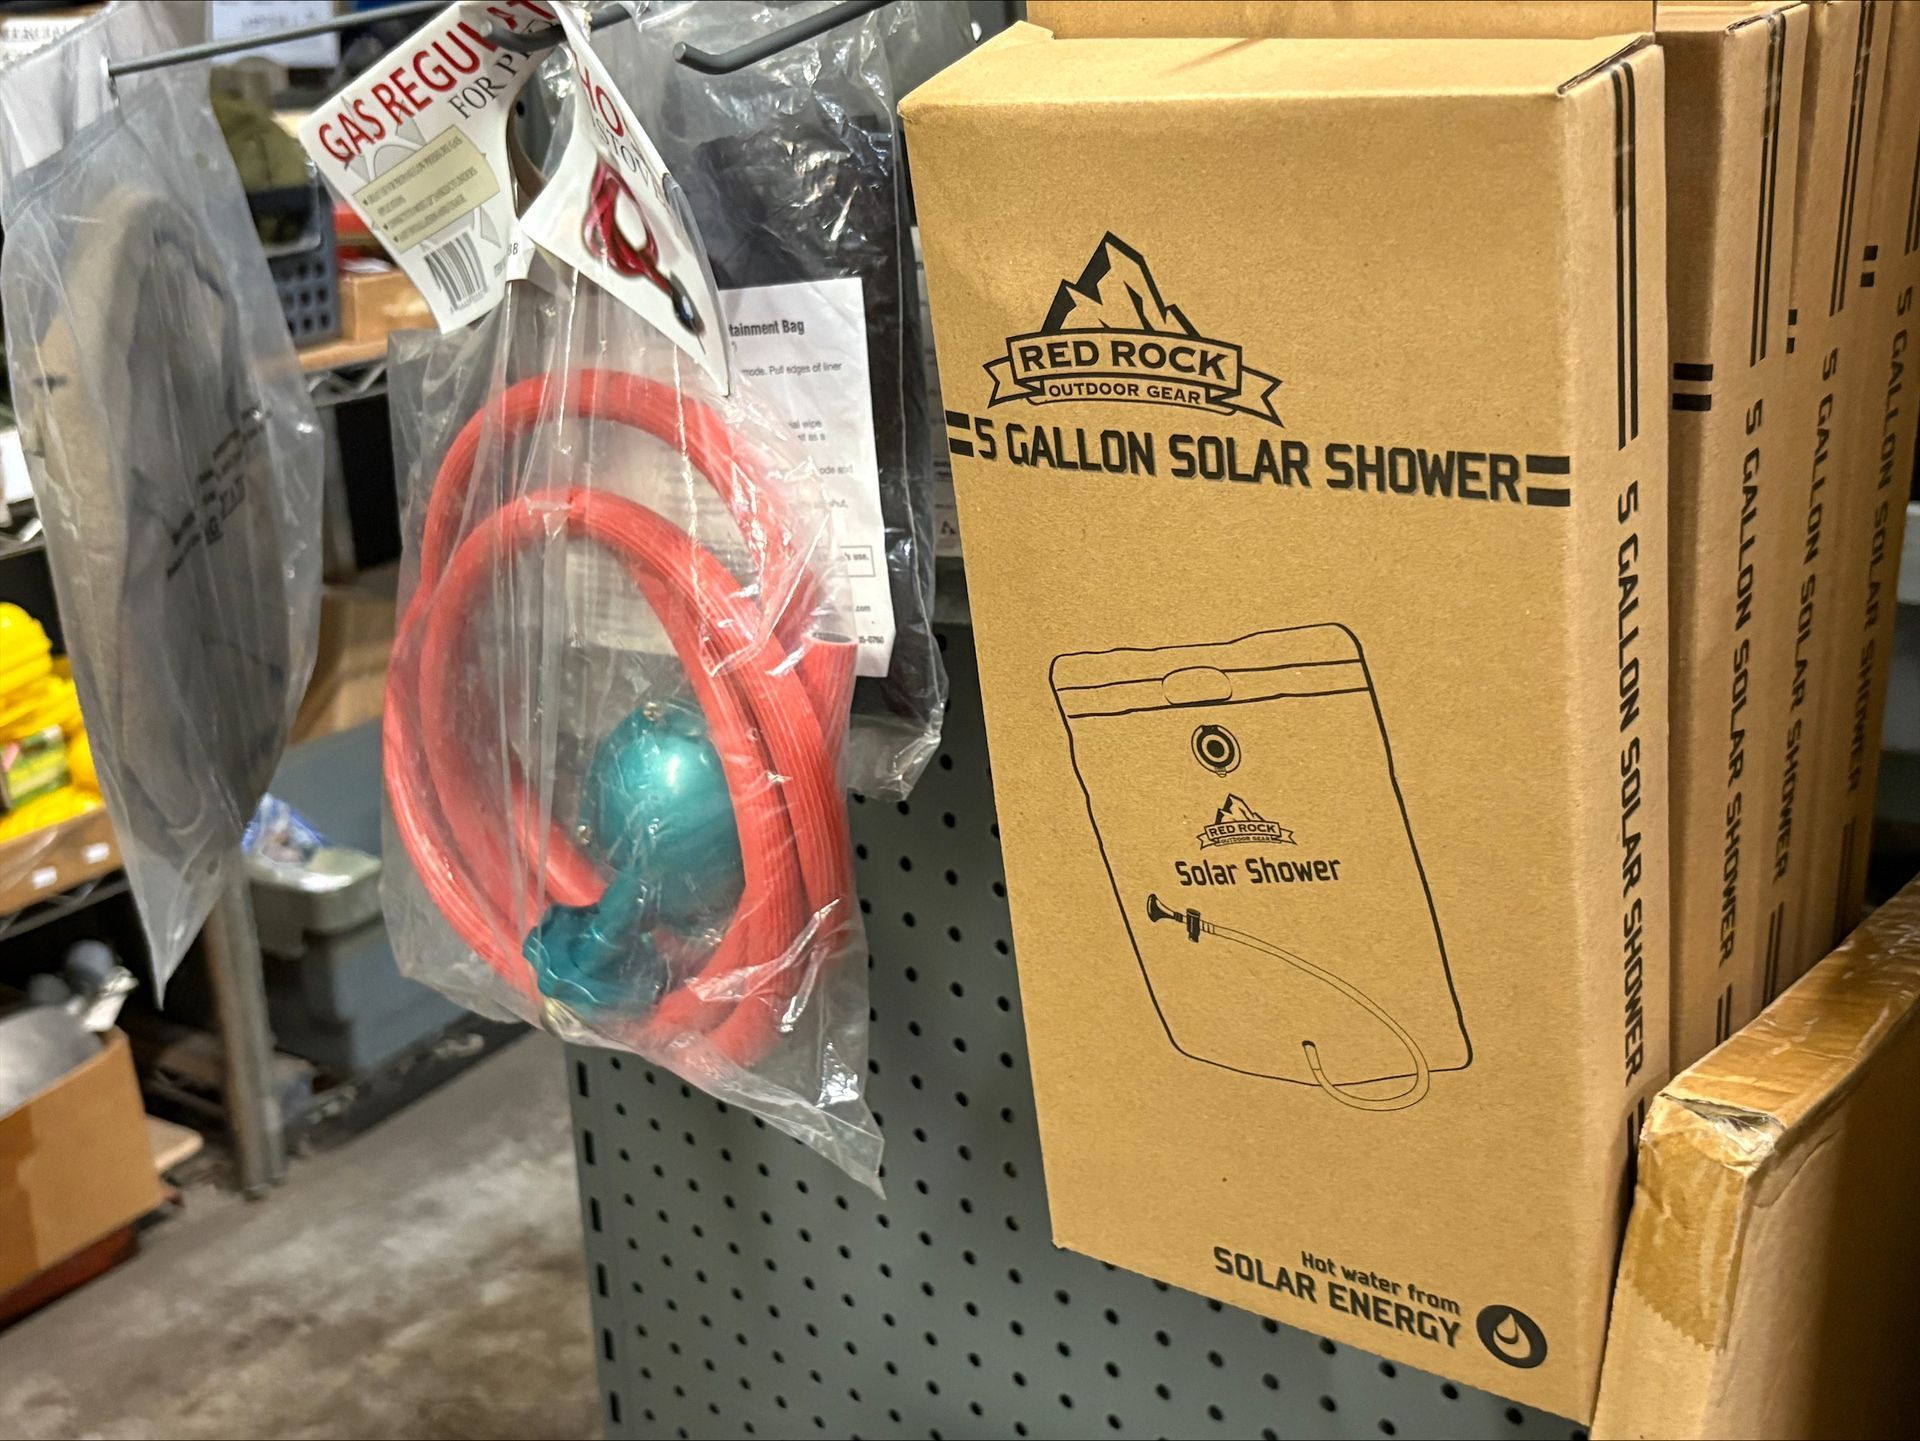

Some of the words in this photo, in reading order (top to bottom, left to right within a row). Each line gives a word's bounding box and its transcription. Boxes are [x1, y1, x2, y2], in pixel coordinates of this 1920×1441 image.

[318, 98, 386, 163] GAS
[447, 76, 506, 120] FOR
[782, 320, 805, 335] Bag
[1896, 285, 1913, 317] 5
[1018, 340, 1099, 373] RED
[1111, 340, 1228, 381] ROCK
[1048, 382, 1140, 397] OUTDOOR
[1146, 385, 1201, 404] GEAR
[1822, 347, 1838, 381] 5
[1746, 398, 1763, 436] 5
[1878, 328, 1908, 491] GALLON
[974, 416, 997, 460] 5
[1005, 422, 1157, 476] GALLON
[1168, 433, 1312, 488] SOLAR
[1325, 442, 1522, 504] SHOWER
[1803, 393, 1834, 566] GALLON
[1617, 479, 1639, 525] 5
[1735, 447, 1760, 632] GALLON
[1863, 500, 1889, 633] SOLAR
[1618, 532, 1640, 734] GALLON
[1791, 573, 1816, 713] SOLAR
[1727, 638, 1750, 788] SOLAR
[1208, 823, 1236, 838] RED
[1238, 822, 1277, 834] ROCK
[1220, 836, 1251, 844] OUTDOOR
[1620, 735, 1643, 899] SOLAR
[1772, 717, 1802, 886] SHOWER
[1174, 859, 1240, 887] Solar
[1244, 856, 1342, 885] Shower
[1718, 791, 1742, 970] SHOWER
[1623, 897, 1645, 1089] SHOWER
[1212, 1245, 1319, 1304] SOLAR
[1327, 1280, 1462, 1350] ENERGY
[1300, 1250, 1337, 1278] Hot
[1341, 1265, 1402, 1297] water
[1407, 1283, 1462, 1317] from
